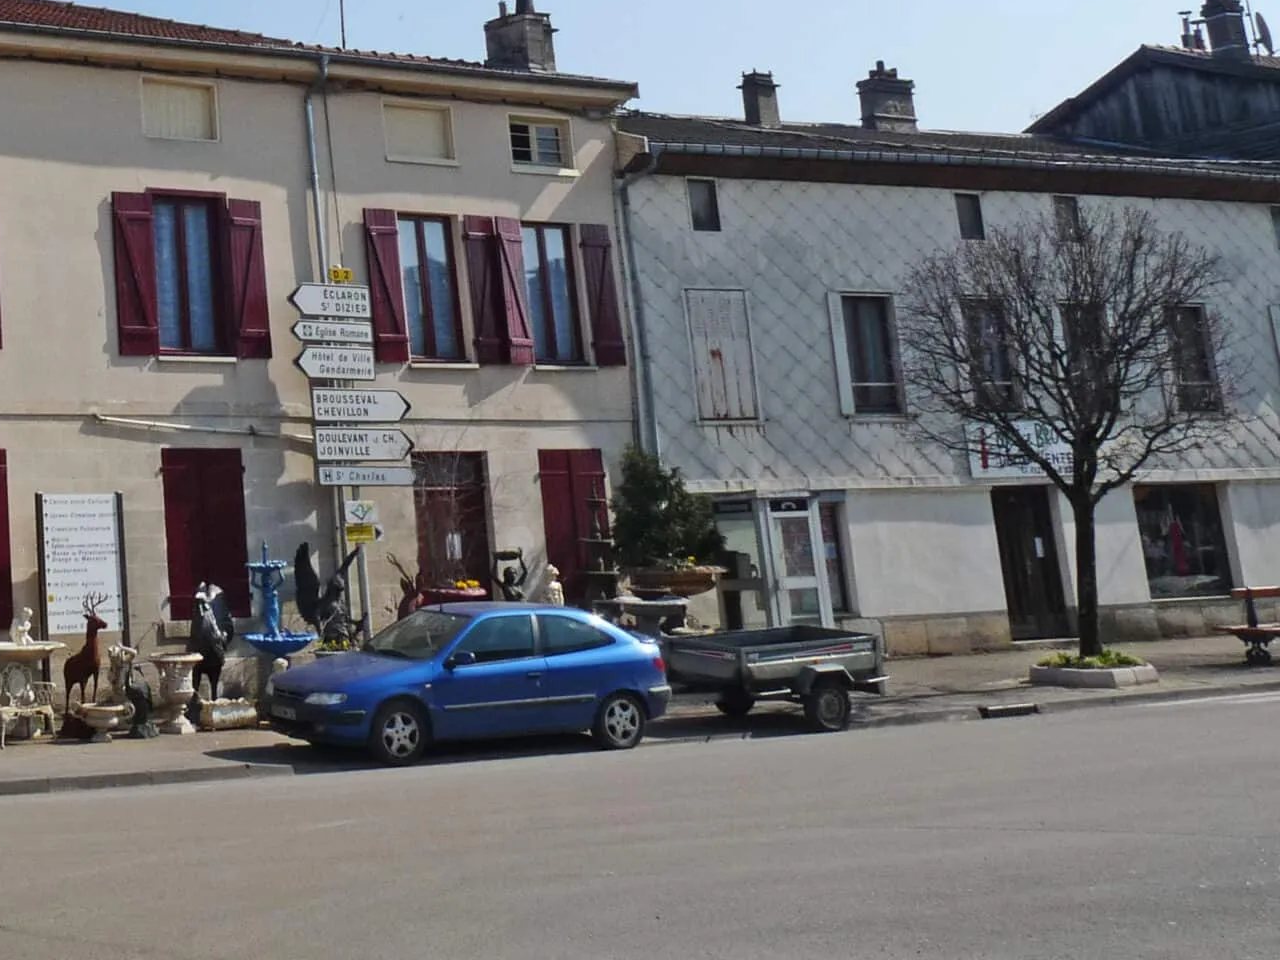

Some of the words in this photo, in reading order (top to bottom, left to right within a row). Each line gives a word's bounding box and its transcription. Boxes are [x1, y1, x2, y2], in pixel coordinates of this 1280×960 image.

[333, 270, 340, 280] D
[343, 270, 350, 280] 2
[323, 288, 367, 301] ÉCLARON
[335, 302, 368, 313] DIZIER
[352, 353, 371, 363] Ville
[320, 364, 372, 375] Gendarmerie
[315, 393, 379, 405] BROUSSEVAL
[317, 407, 369, 417] CHEVILLON
[319, 433, 369, 444] DOULEVANT
[320, 446, 371, 456] JOINVILLE
